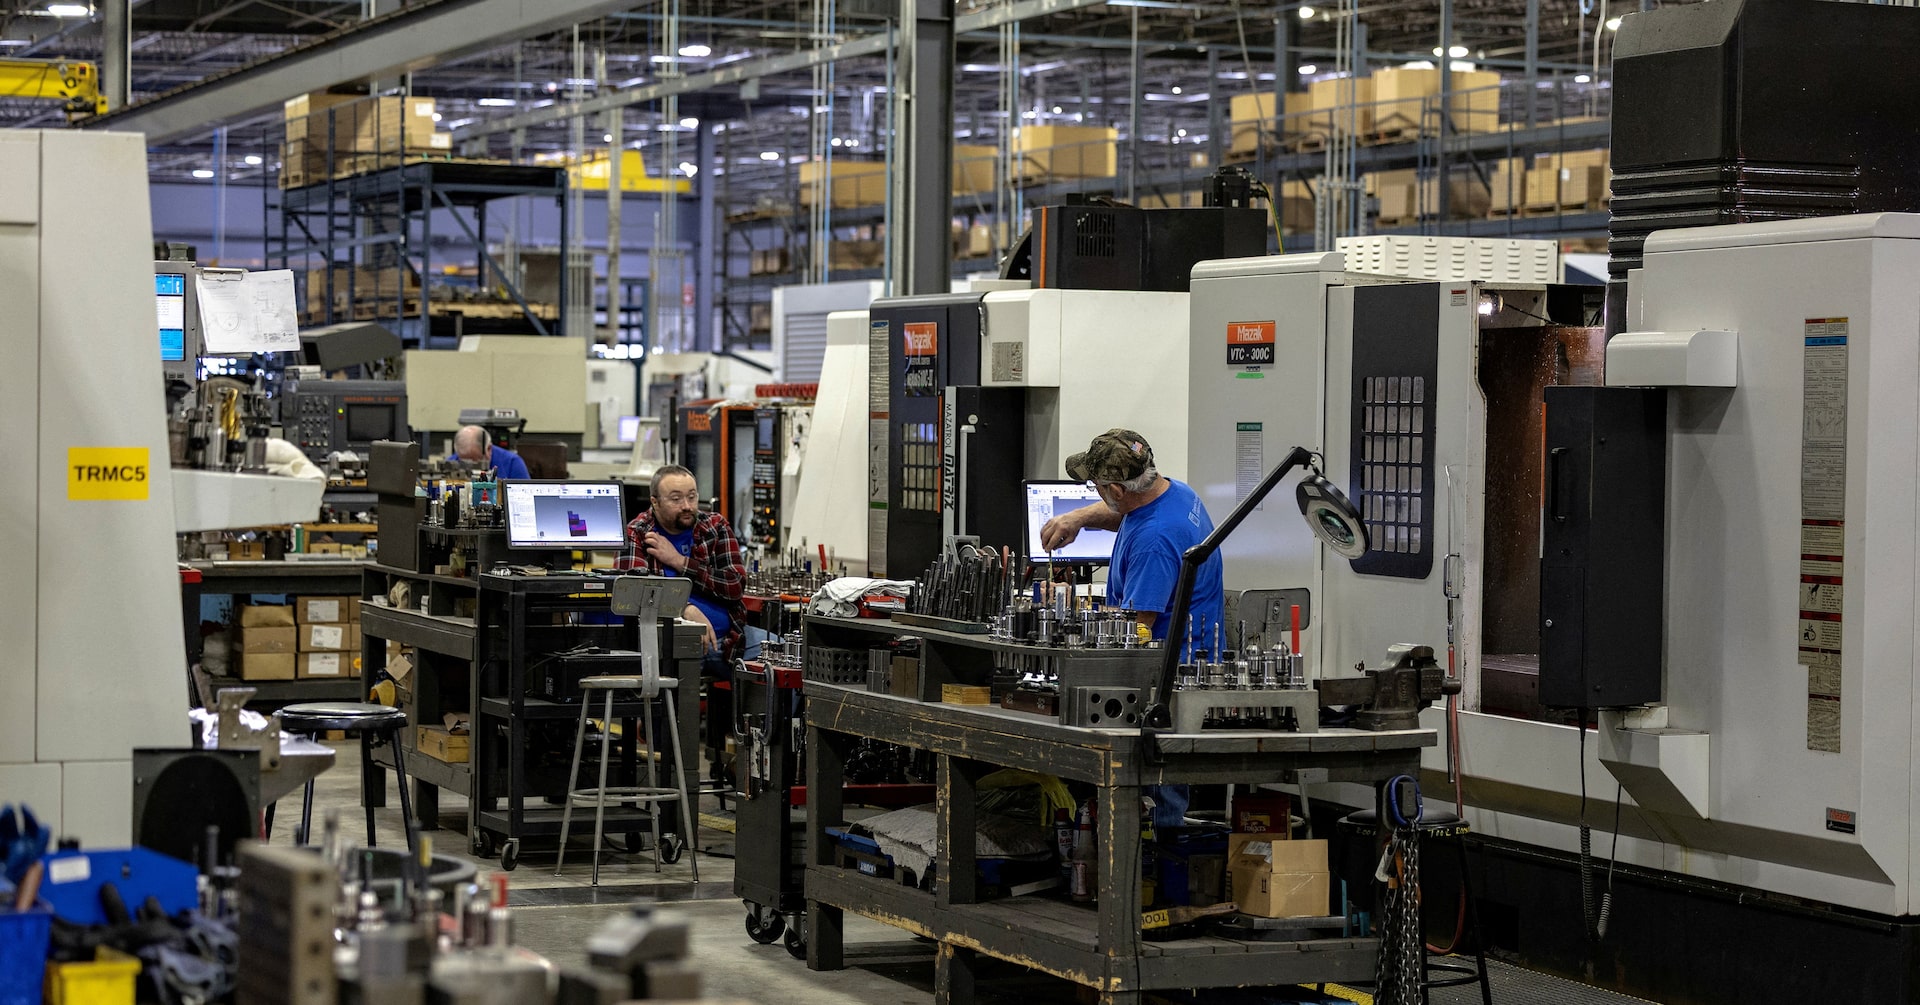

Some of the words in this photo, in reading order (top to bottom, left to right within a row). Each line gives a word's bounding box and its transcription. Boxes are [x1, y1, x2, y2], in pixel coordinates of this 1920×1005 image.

[1237, 325, 1263, 341] Mazak
[1231, 348, 1245, 360] VTC
[1251, 347, 1270, 360] 300C
[73, 465, 146, 482] TRMC5
